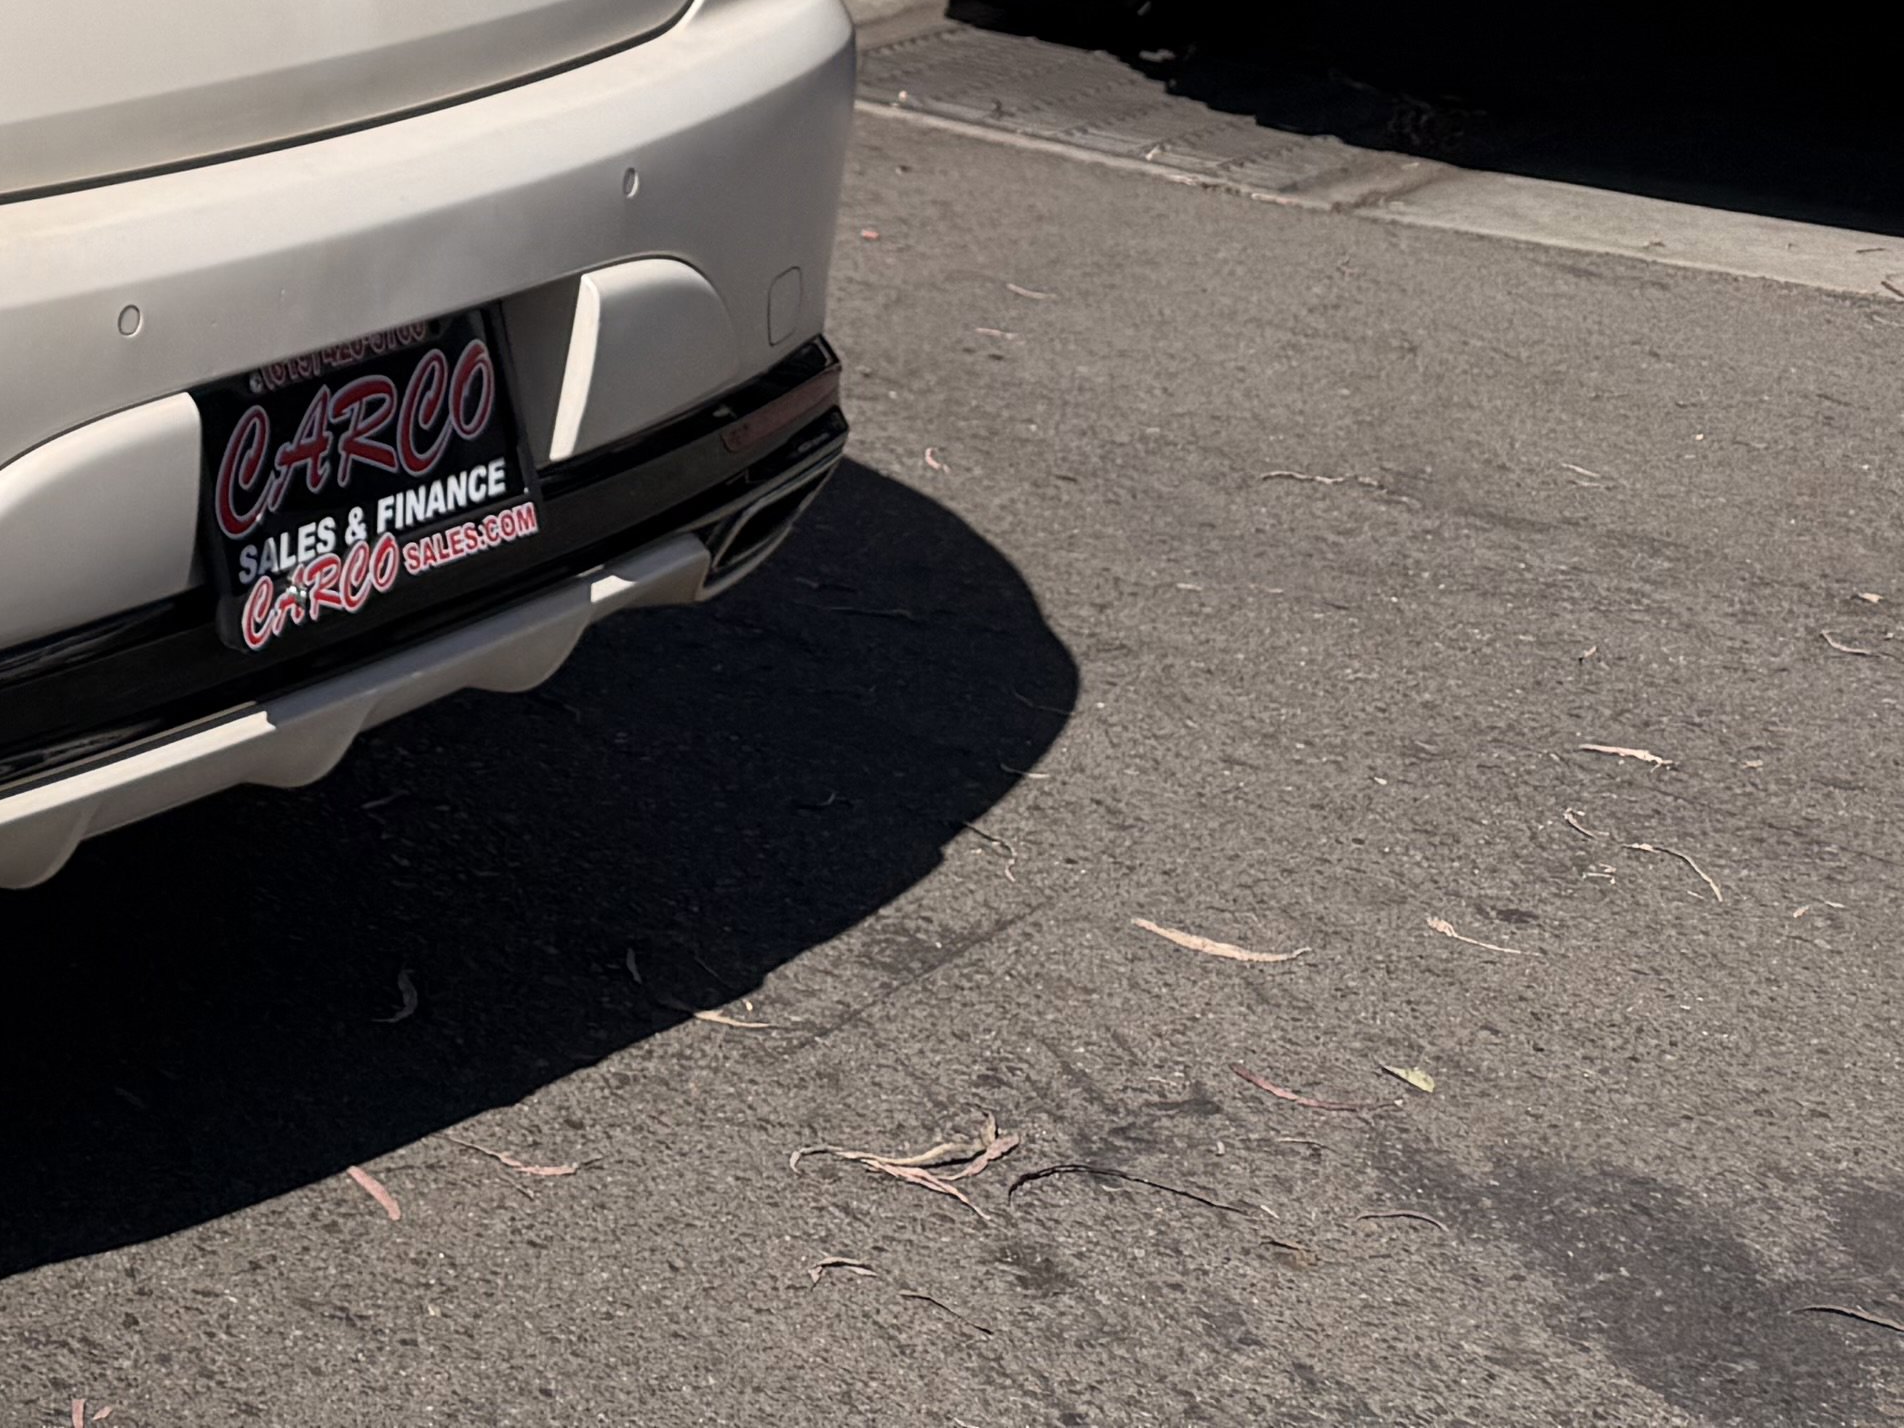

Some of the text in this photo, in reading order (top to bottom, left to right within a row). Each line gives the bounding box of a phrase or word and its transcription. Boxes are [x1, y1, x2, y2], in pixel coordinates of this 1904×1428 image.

[216, 339, 495, 540] CARCO
[238, 457, 507, 584] SALES & FINANCE
[242, 502, 539, 651] CARCO SALES.COM
